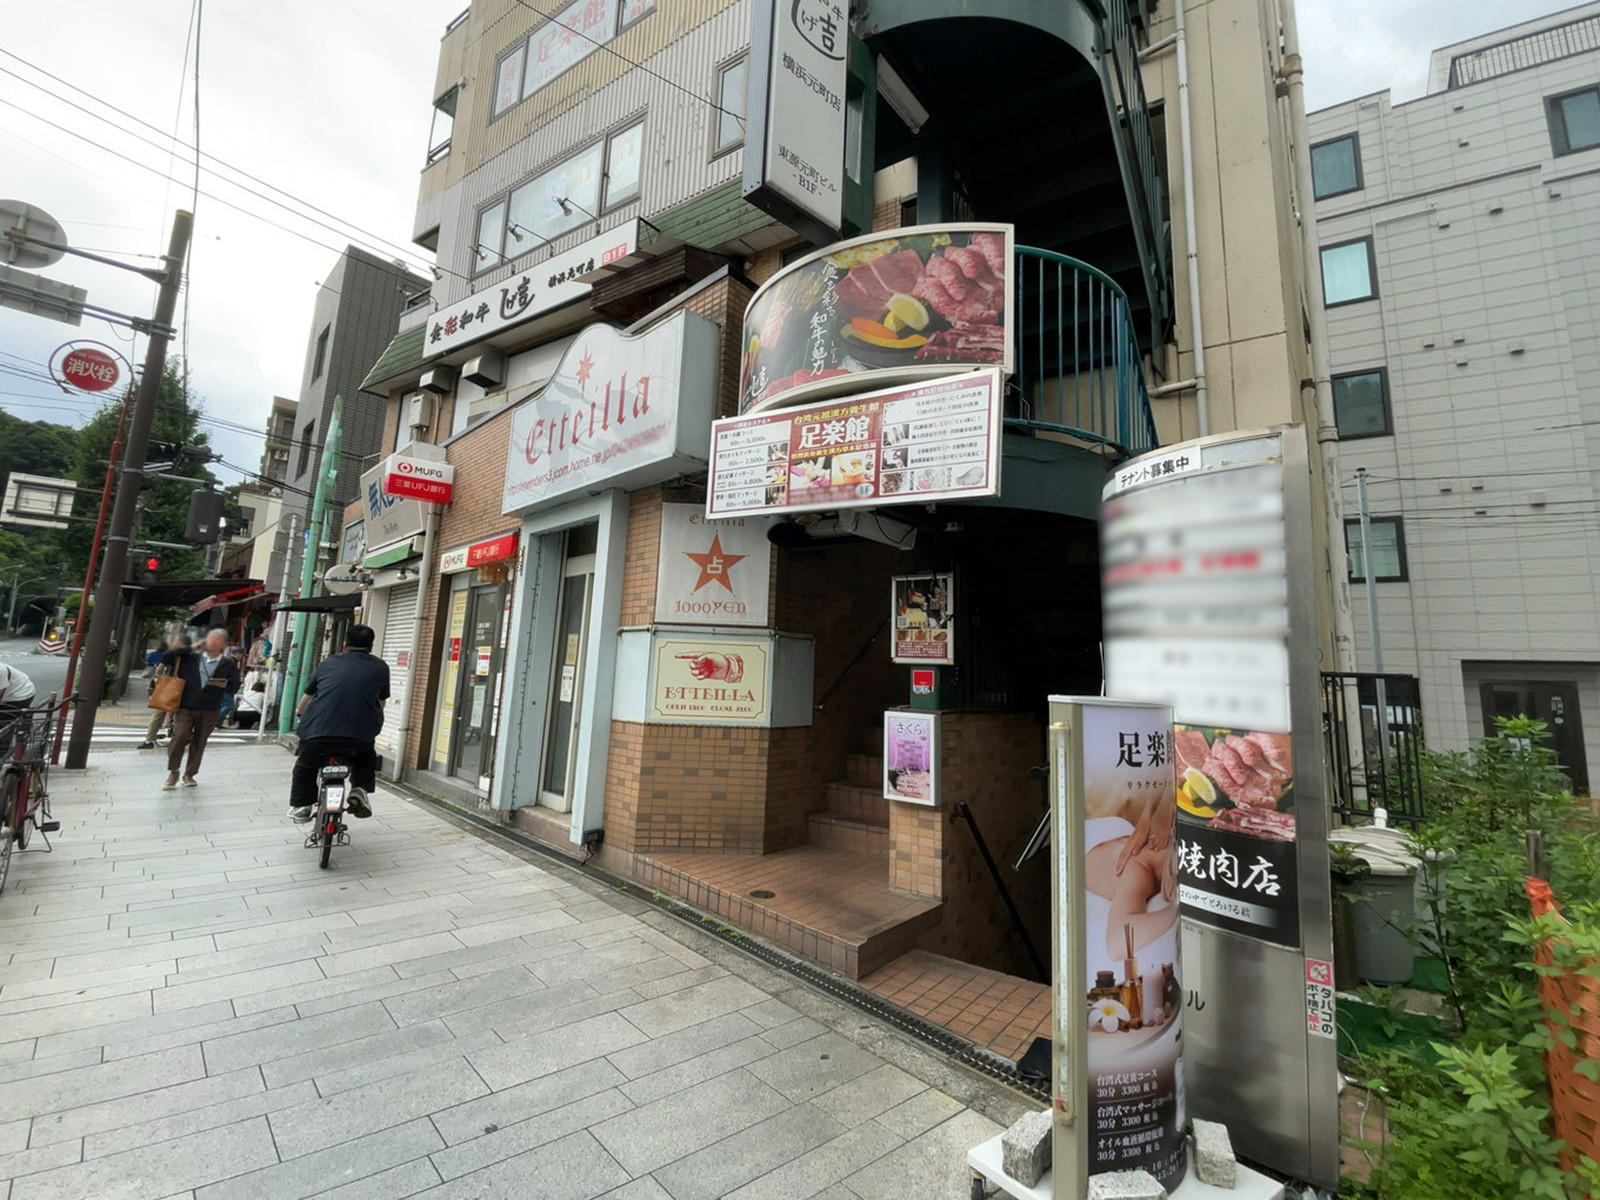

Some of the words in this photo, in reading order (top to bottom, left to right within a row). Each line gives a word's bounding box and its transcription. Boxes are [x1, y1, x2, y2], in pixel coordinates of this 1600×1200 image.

[782, 52, 841, 112] 横浜元町店
[778, 144, 837, 192] 東源元町ビル
[430, 302, 490, 344] 食彩和牛
[547, 257, 595, 288] 横浜元町店
[603, 245, 626, 264] B1F
[810, 311, 828, 377] 和牛の魅力
[66, 356, 116, 383] 消火栓
[525, 370, 652, 466] Etteilla
[798, 415, 870, 450] 足楽館
[414, 465, 443, 479] MUFG
[1120, 456, 1190, 488] テナント募集中
[394, 478, 446, 495] 三菱UFJ銀行
[450, 552, 465, 564] MUFG
[706, 556, 724, 574] 占
[664, 686, 756, 703] ETTEILLA
[896, 722, 922, 734] さくら
[1178, 838, 1281, 897] 焼肉店
[1306, 983, 1320, 1032] ポイ捨て禁止
[1097, 1069, 1158, 1087] 台湾式足裏コース
[1097, 1087, 1116, 1098] 30分
[1121, 1084, 1141, 1096] 3300
[1097, 1118, 1116, 1129] 30分
[1121, 1115, 1141, 1127] 3300
[1097, 1150, 1116, 1161] 30分
[1121, 1147, 1141, 1159] 3300
